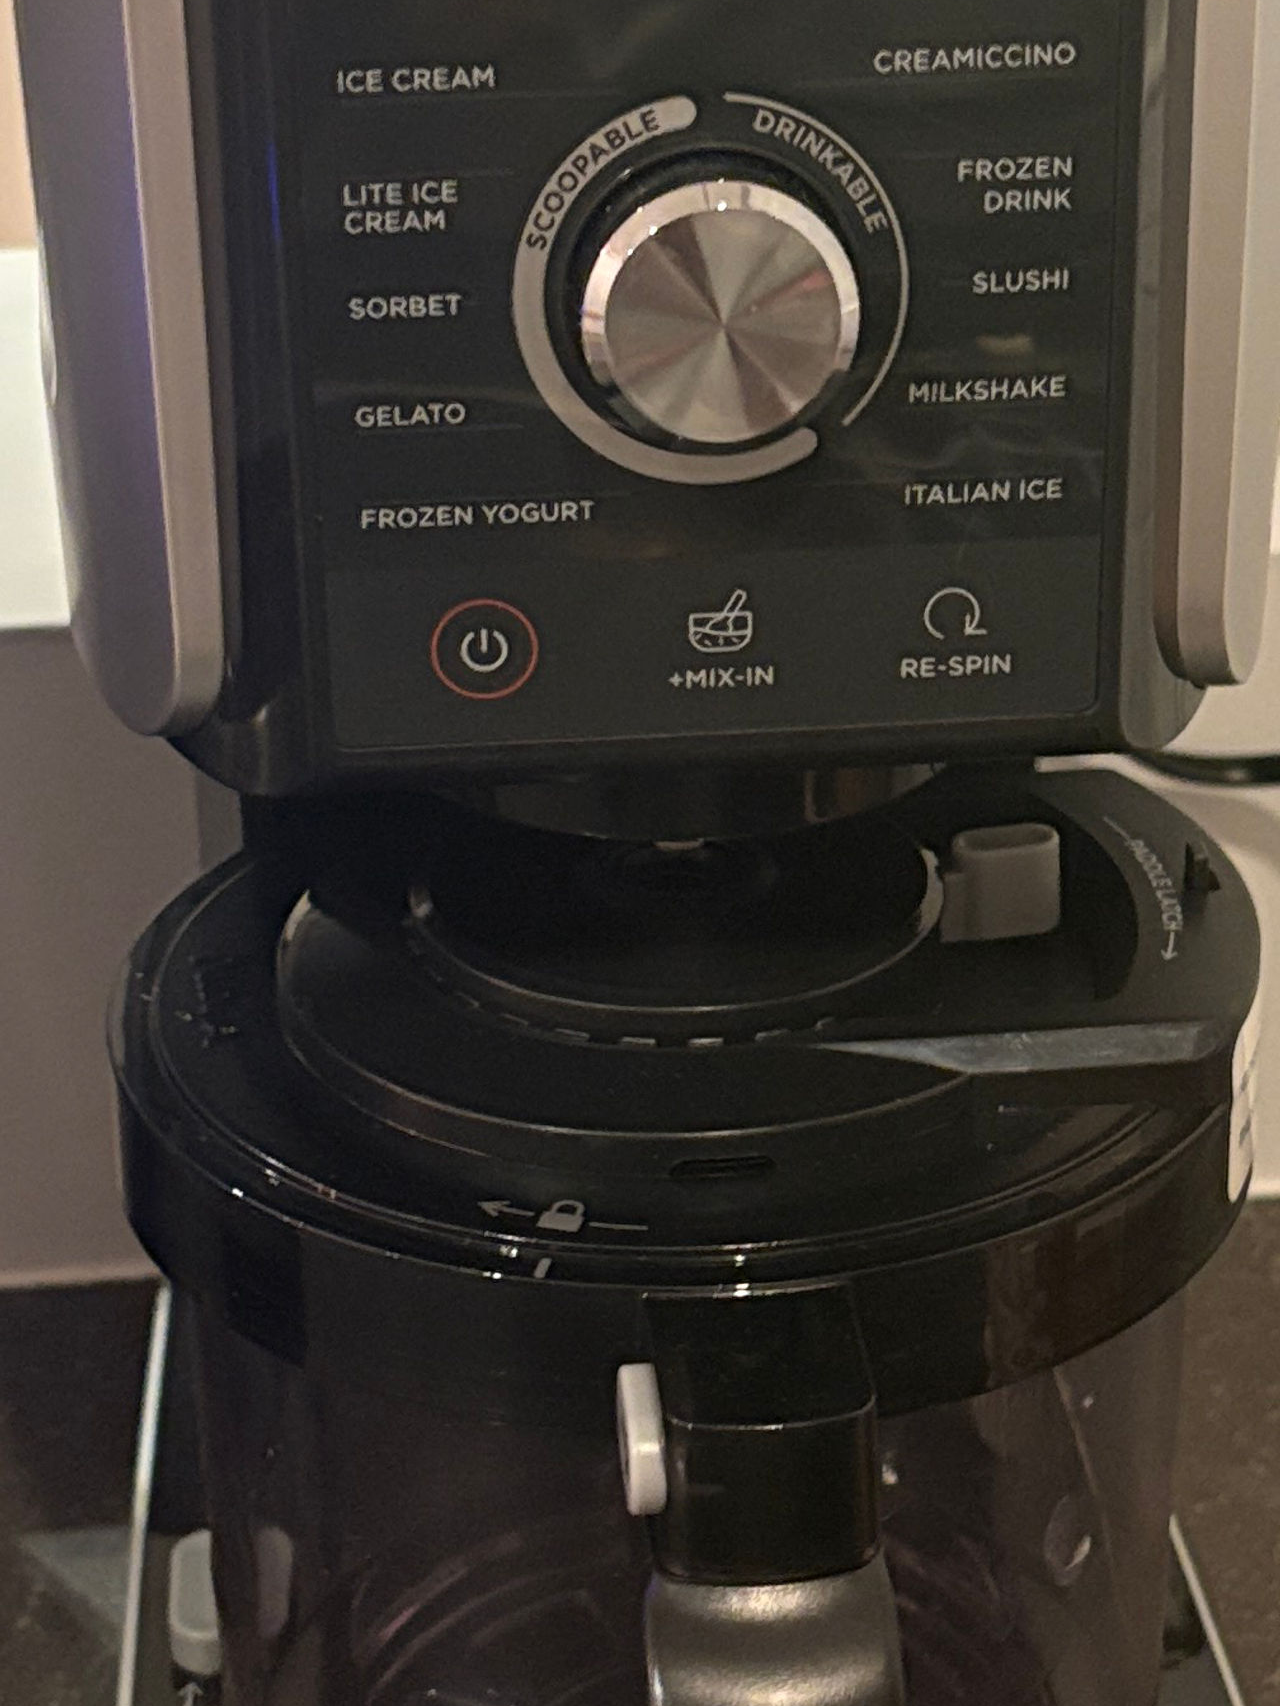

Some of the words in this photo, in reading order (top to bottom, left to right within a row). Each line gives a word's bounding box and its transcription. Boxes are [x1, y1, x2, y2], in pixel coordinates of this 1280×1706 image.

[873, 42, 1076, 74] CREAMICCINO
[336, 69, 383, 93] ICE
[391, 64, 496, 91] CREAM
[524, 108, 661, 251] SCOOPABLE
[753, 109, 889, 234] DRINKABLE
[957, 156, 1073, 182] FROZEN
[343, 182, 403, 207] LITE
[412, 180, 458, 204] ICE
[983, 188, 1071, 214] DRINK
[344, 209, 446, 235] CREAM
[972, 268, 1069, 294] SLUSHI
[348, 293, 461, 320] SORBET
[909, 375, 1066, 403] MILKSHAKE
[354, 402, 466, 428] GELATO
[904, 480, 1011, 505] ITALIAN
[1018, 477, 1062, 500] ICE
[360, 505, 473, 529] FROZEN
[480, 499, 594, 525] YOGURT
[669, 665, 774, 689] +MIX-IN
[900, 654, 1011, 678] RE-SPIN
